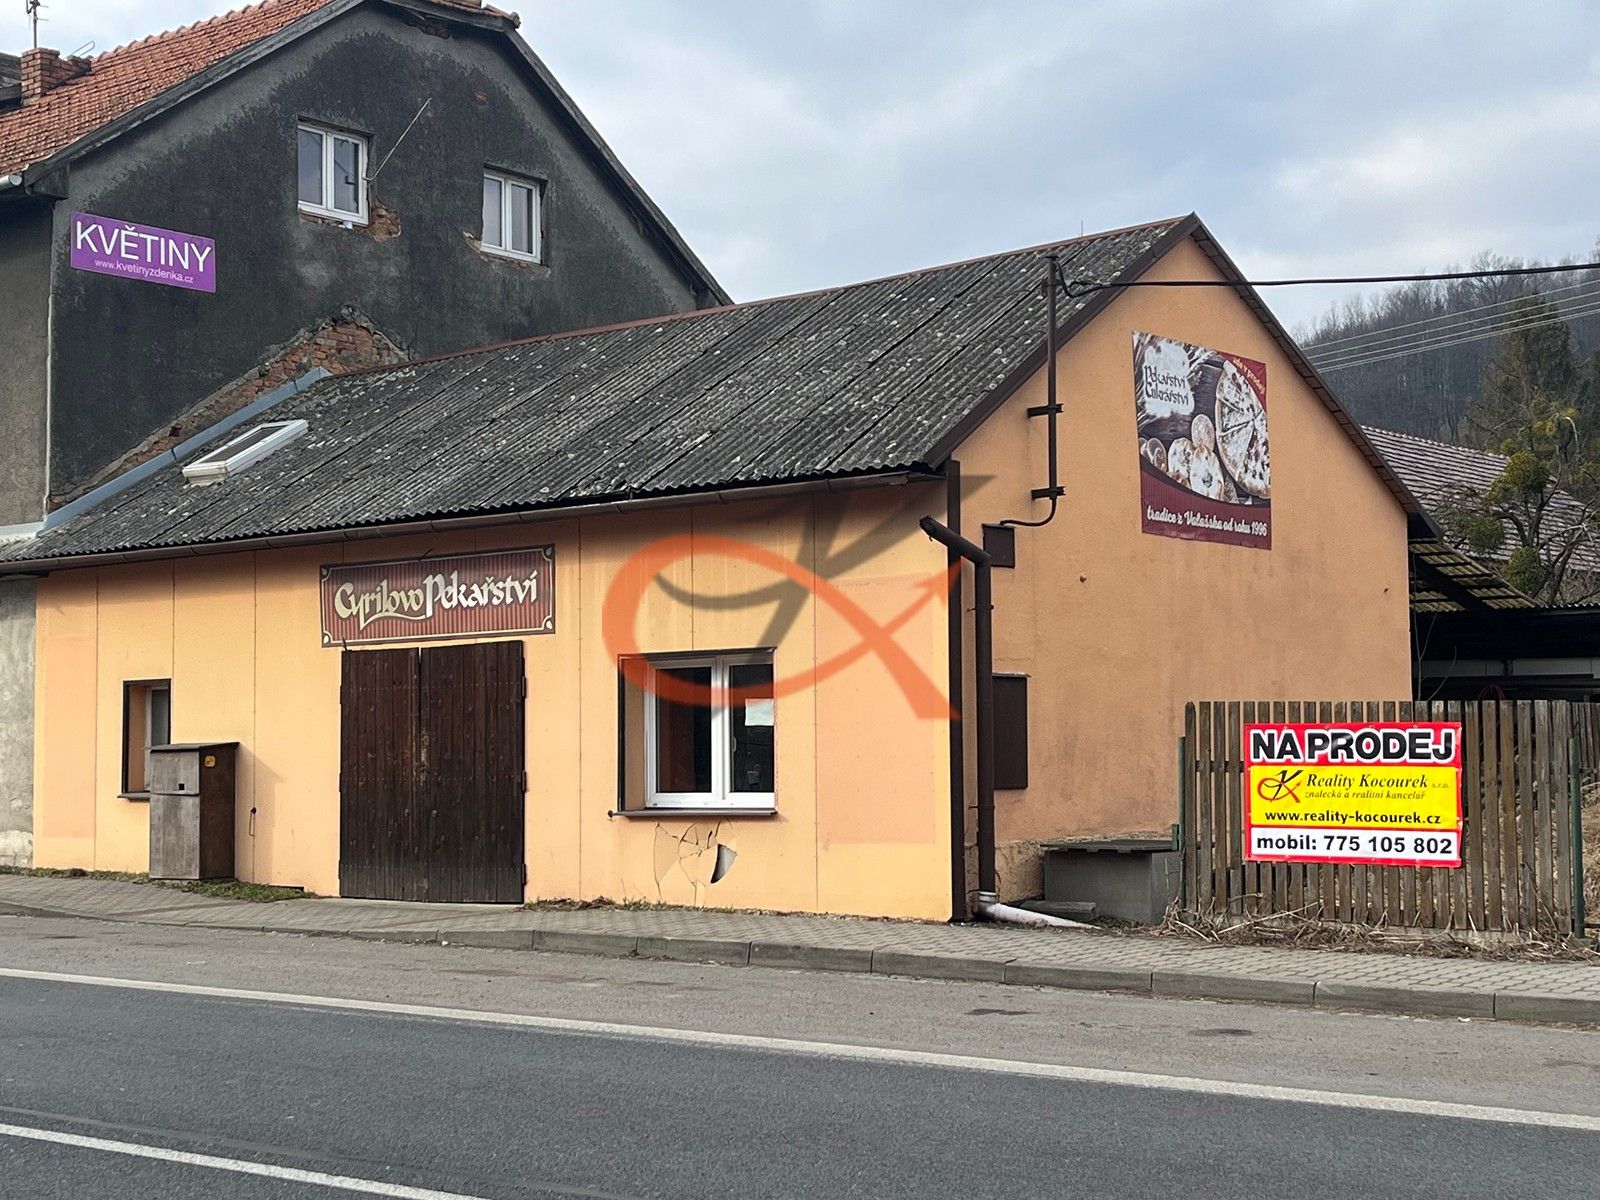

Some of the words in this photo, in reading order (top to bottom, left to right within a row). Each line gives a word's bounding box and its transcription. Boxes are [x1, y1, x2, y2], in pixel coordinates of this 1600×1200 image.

[76, 220, 212, 273] KVĚTINY
[94, 259, 194, 284] www.kvetinyzdenka.cz
[1147, 505, 1177, 524] tradice
[1177, 513, 1183, 525] z
[1184, 510, 1223, 530] Valašska
[1223, 517, 1233, 531] od
[1234, 519, 1251, 534] roku
[334, 578, 427, 631] Cyrilovo
[423, 569, 538, 618] Pekařství
[1251, 731, 1302, 761] NA
[1306, 730, 1454, 761] PRODEJ
[1306, 773, 1355, 790] Reality
[1359, 773, 1429, 789] Kocourek
[1304, 790, 1343, 799] znalecká
[1351, 790, 1384, 799] realitní
[1386, 790, 1426, 800] kancelář
[1265, 809, 1441, 825] www.reality-kocourek.cz
[1256, 834, 1317, 850] mobil:
[1323, 834, 1361, 852] 775
[1368, 835, 1406, 853] 105
[1413, 837, 1453, 855] 802
